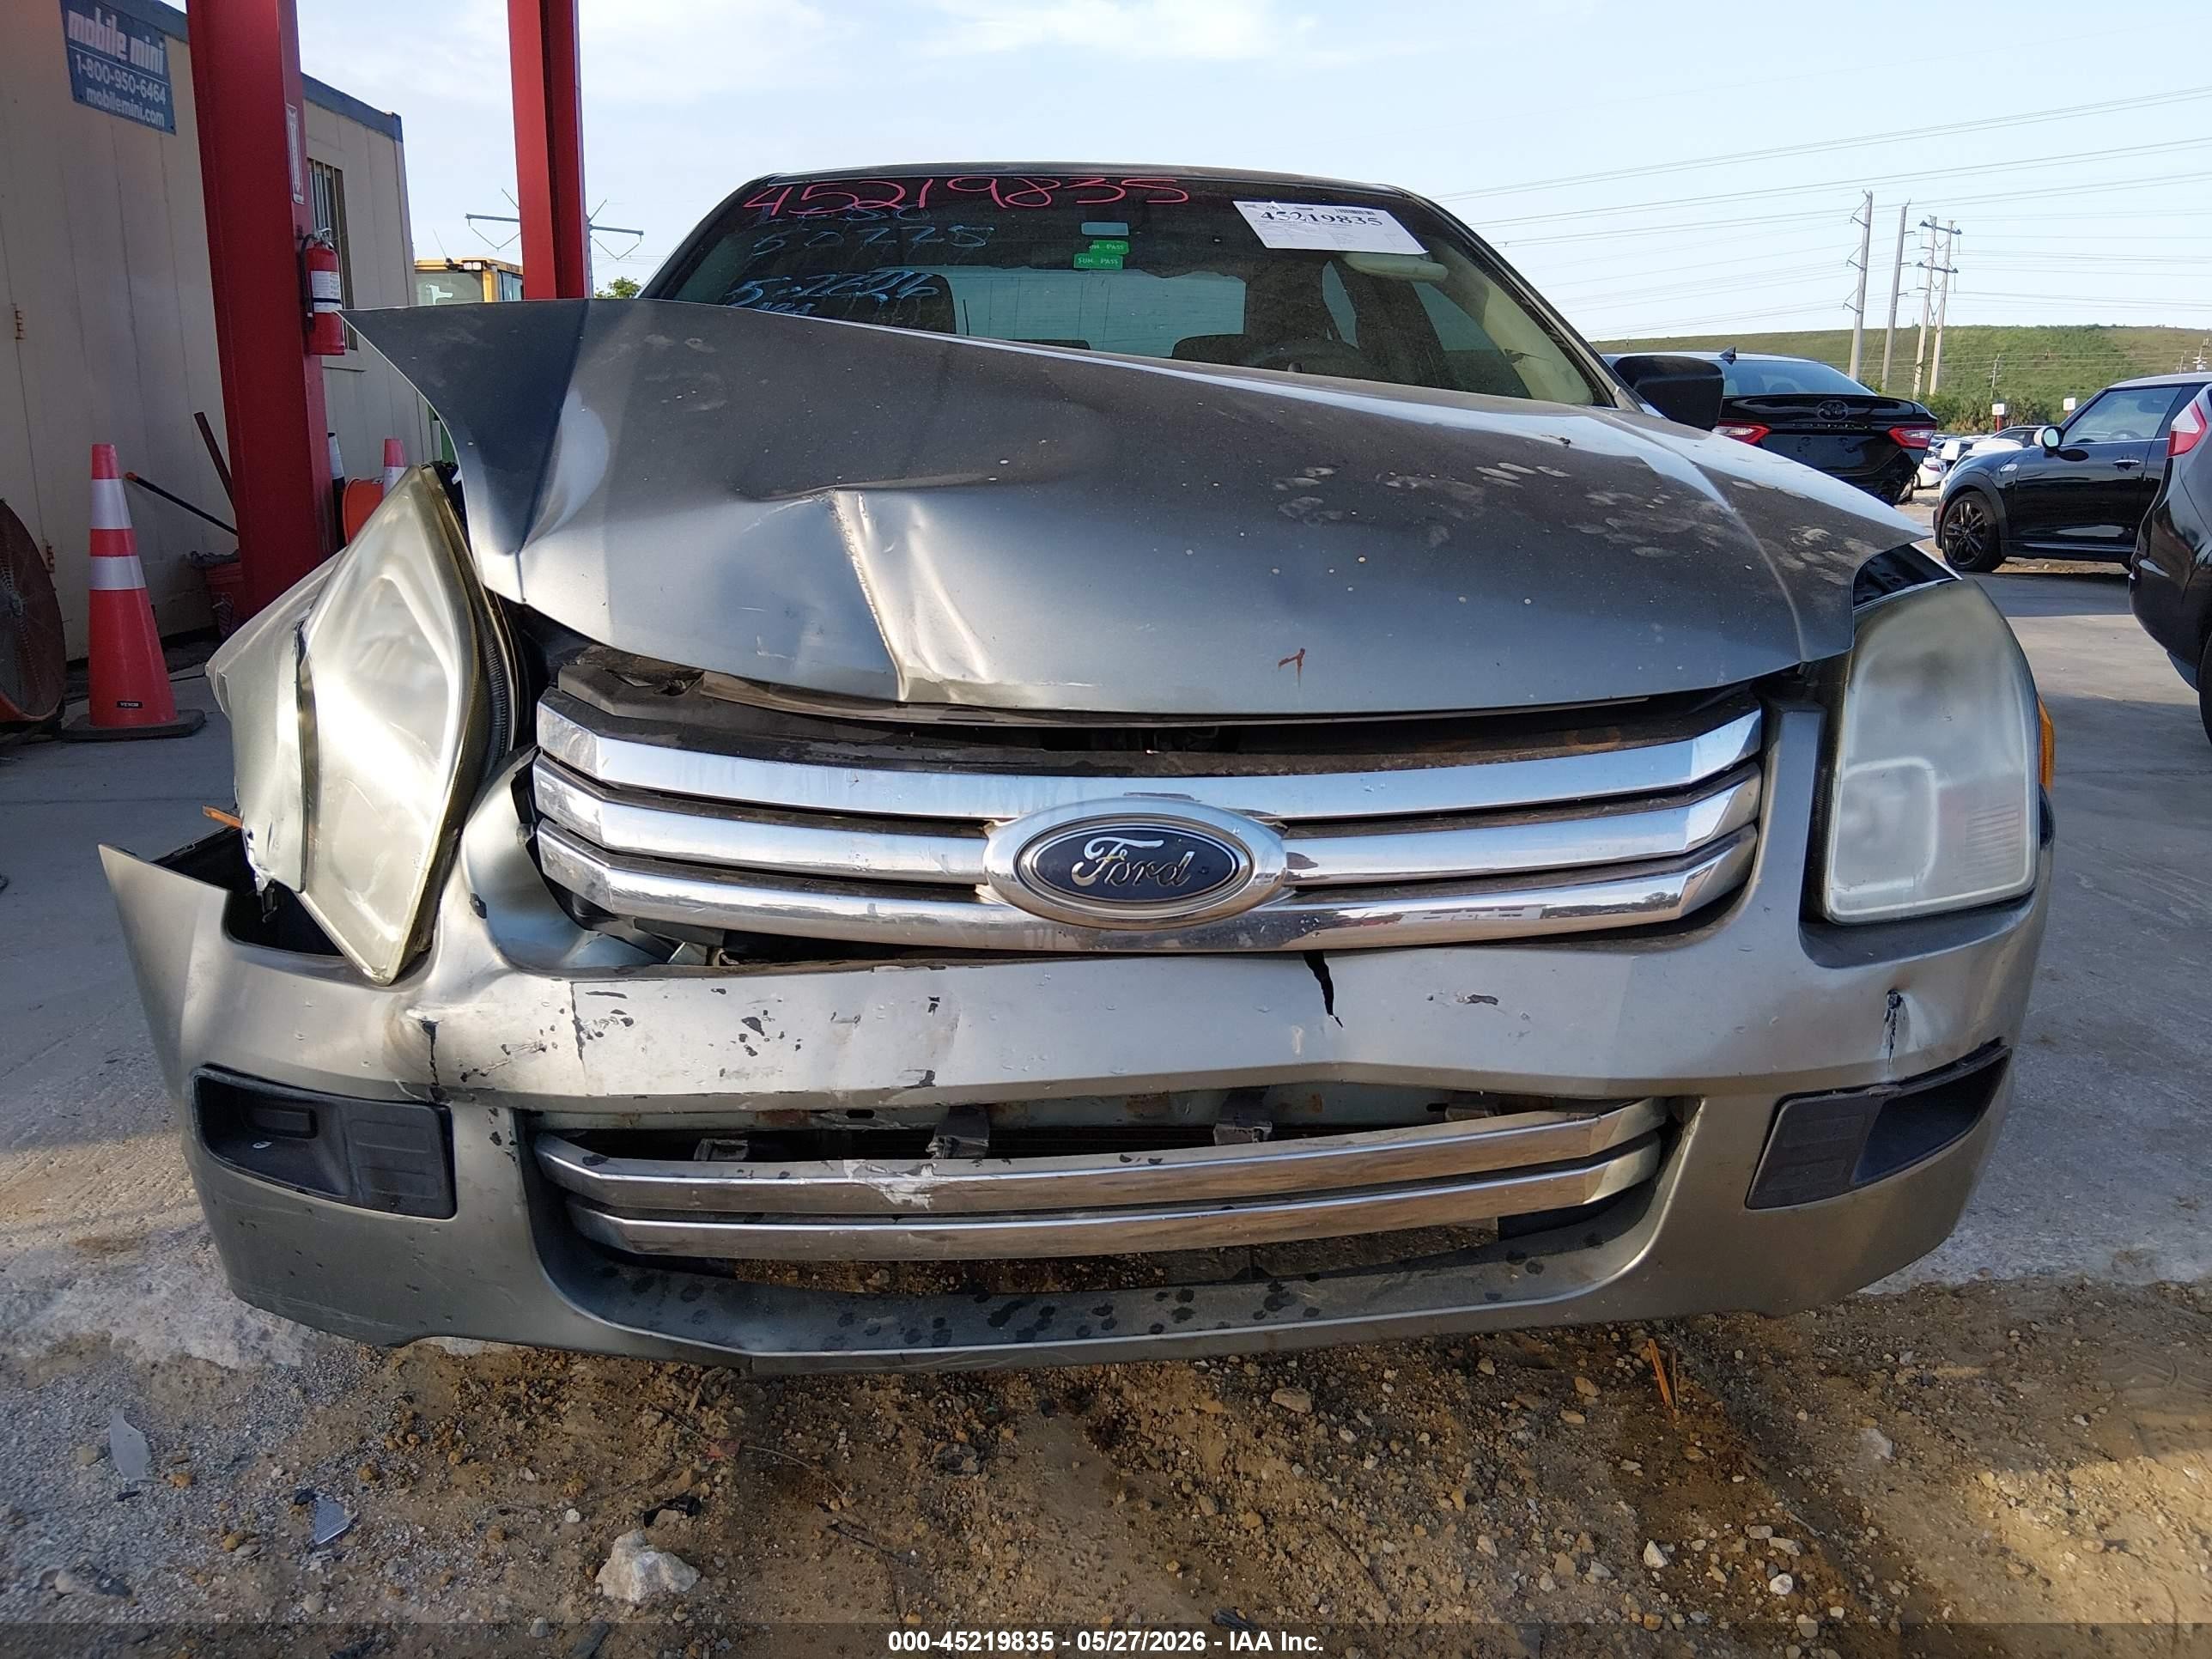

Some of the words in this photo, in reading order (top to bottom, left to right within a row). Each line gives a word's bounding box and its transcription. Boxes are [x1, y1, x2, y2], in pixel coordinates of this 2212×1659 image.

[68, 7, 128, 61] mobile
[130, 35, 165, 76] mini
[76, 53, 167, 105] 1-800-950-6464
[86, 87, 166, 127] mobilemini.com
[743, 175, 1190, 216] 45219835
[1260, 210, 1383, 227] 45219835
[1071, 836, 1196, 888] Ford
